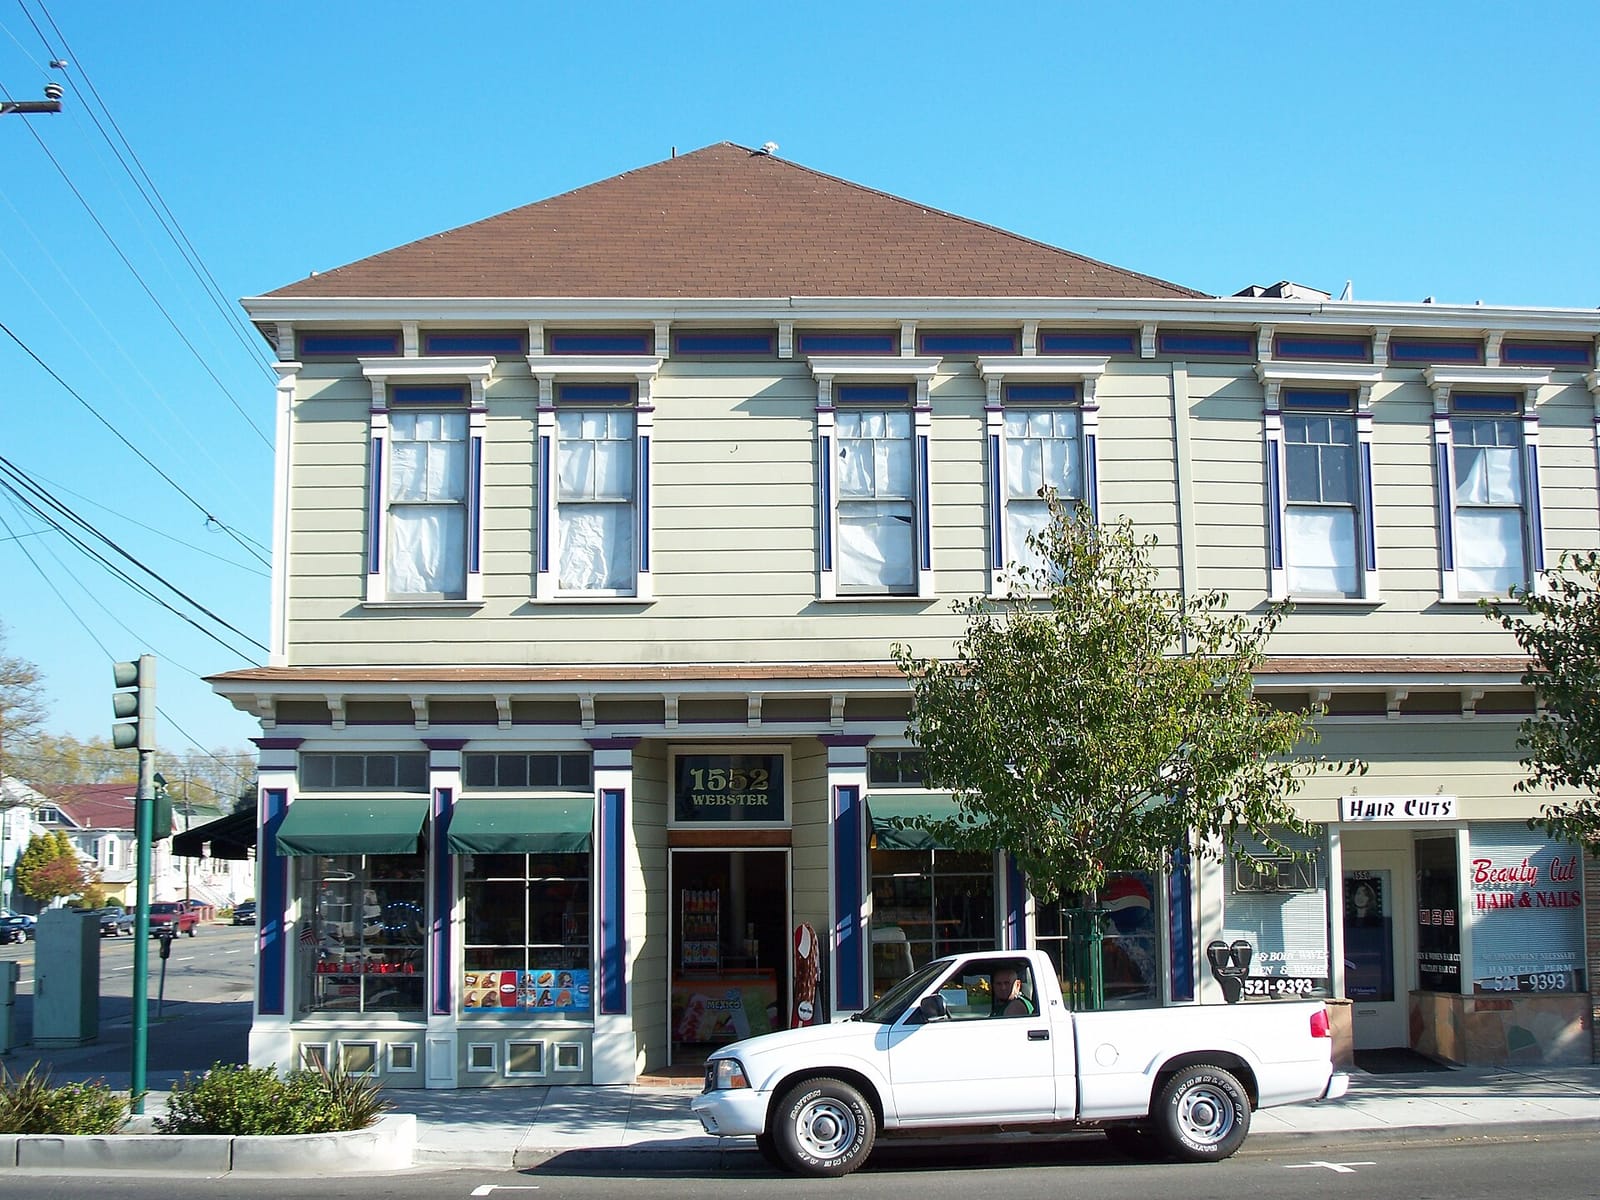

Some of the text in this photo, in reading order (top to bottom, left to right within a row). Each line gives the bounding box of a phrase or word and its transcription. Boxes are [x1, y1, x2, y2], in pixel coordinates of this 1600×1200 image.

[690, 768, 768, 790] 1552
[691, 794, 768, 805] WEBSTER
[1350, 800, 1451, 816] HAIR CUTS
[1472, 856, 1577, 887] Beauty Cut
[1476, 890, 1581, 909] HAIR & NAILS
[1259, 952, 1267, 961] &
[1279, 965, 1288, 975] &
[1489, 964, 1572, 974] HAIR CUT PERM
[1244, 978, 1312, 995] 521-9393
[1494, 973, 1565, 991] 521-9393
[706, 999, 741, 1009] MEXICO
